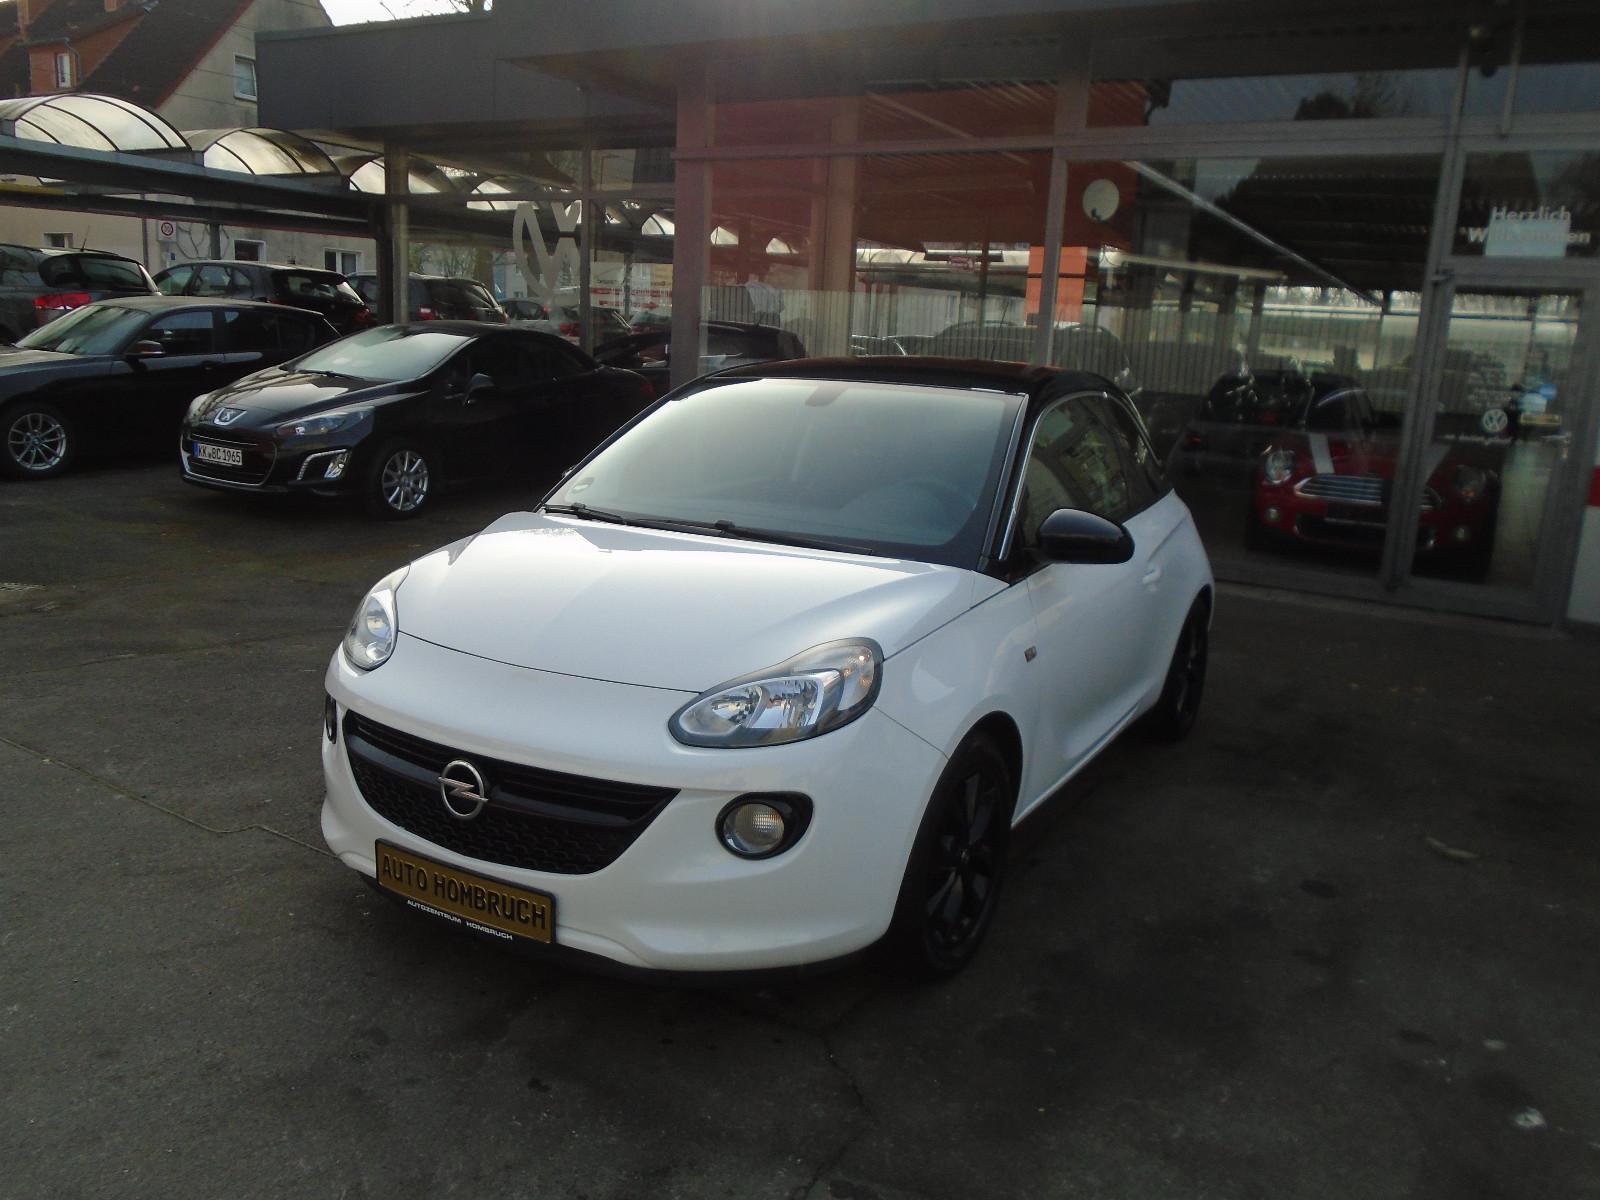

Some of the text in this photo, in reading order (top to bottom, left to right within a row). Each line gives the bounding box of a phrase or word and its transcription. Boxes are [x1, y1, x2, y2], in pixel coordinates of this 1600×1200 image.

[1491, 205, 1571, 224] Herzlich
[222, 449, 241, 463] 1965
[383, 854, 546, 929] AUTO HOMBRUCH
[407, 900, 513, 940] AUTOZENTRUM HOMBRUCH
